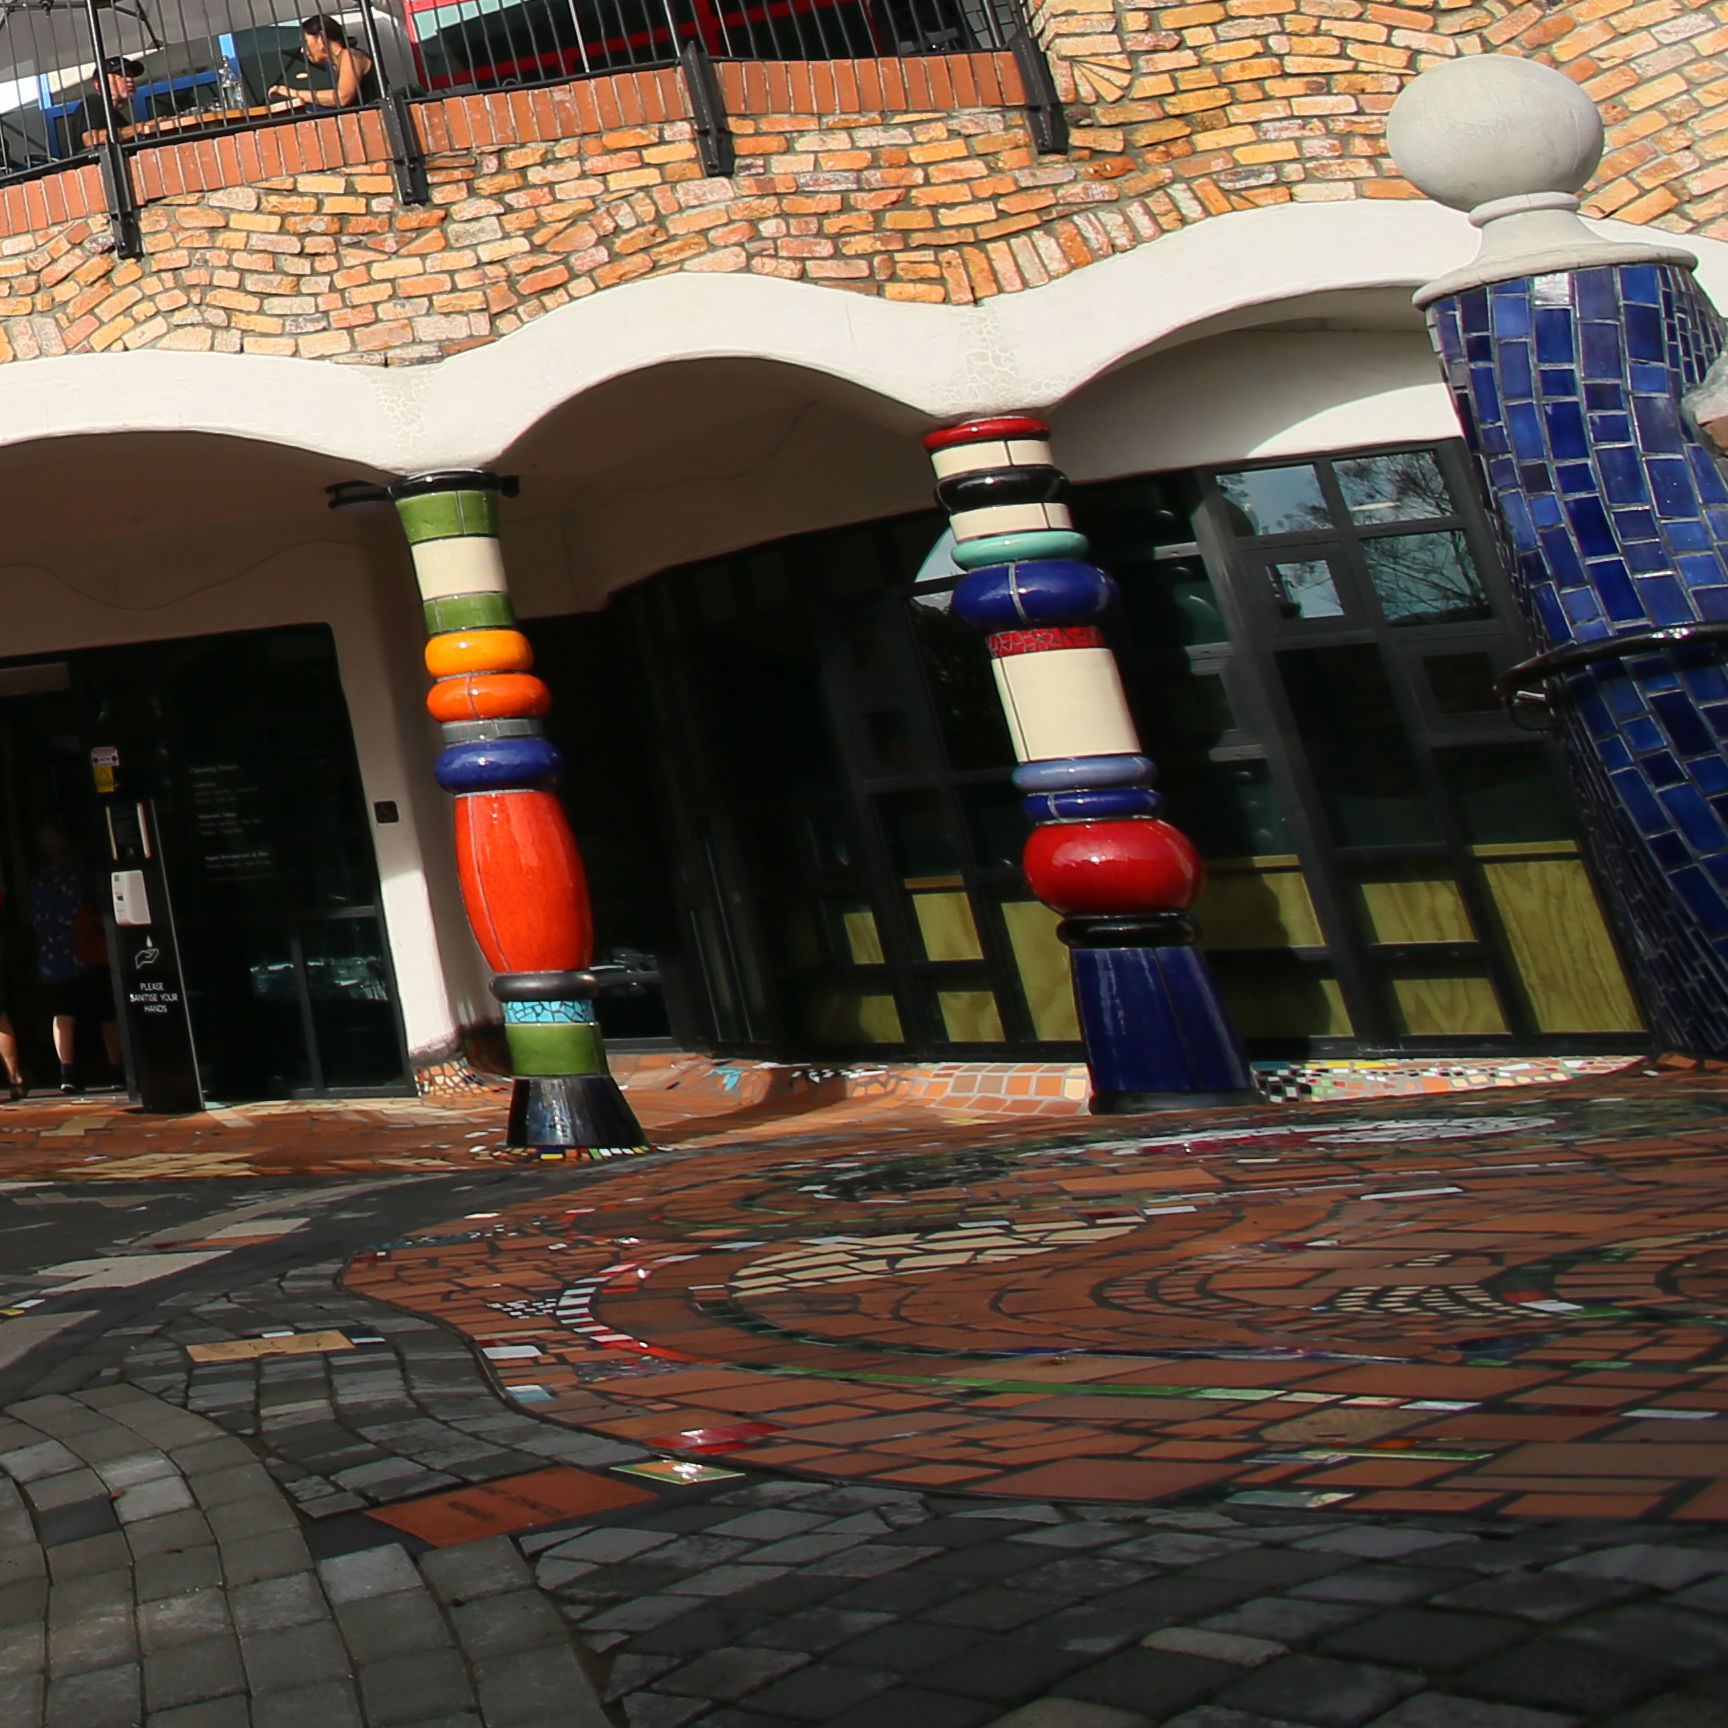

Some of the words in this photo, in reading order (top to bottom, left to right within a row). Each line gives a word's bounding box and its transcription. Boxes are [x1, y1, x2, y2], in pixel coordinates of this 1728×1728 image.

[140, 982, 164, 991] PLEASE
[129, 993, 158, 1002] SANITISE
[159, 993, 178, 1002] YOUR
[144, 1004, 168, 1013] HANDS
